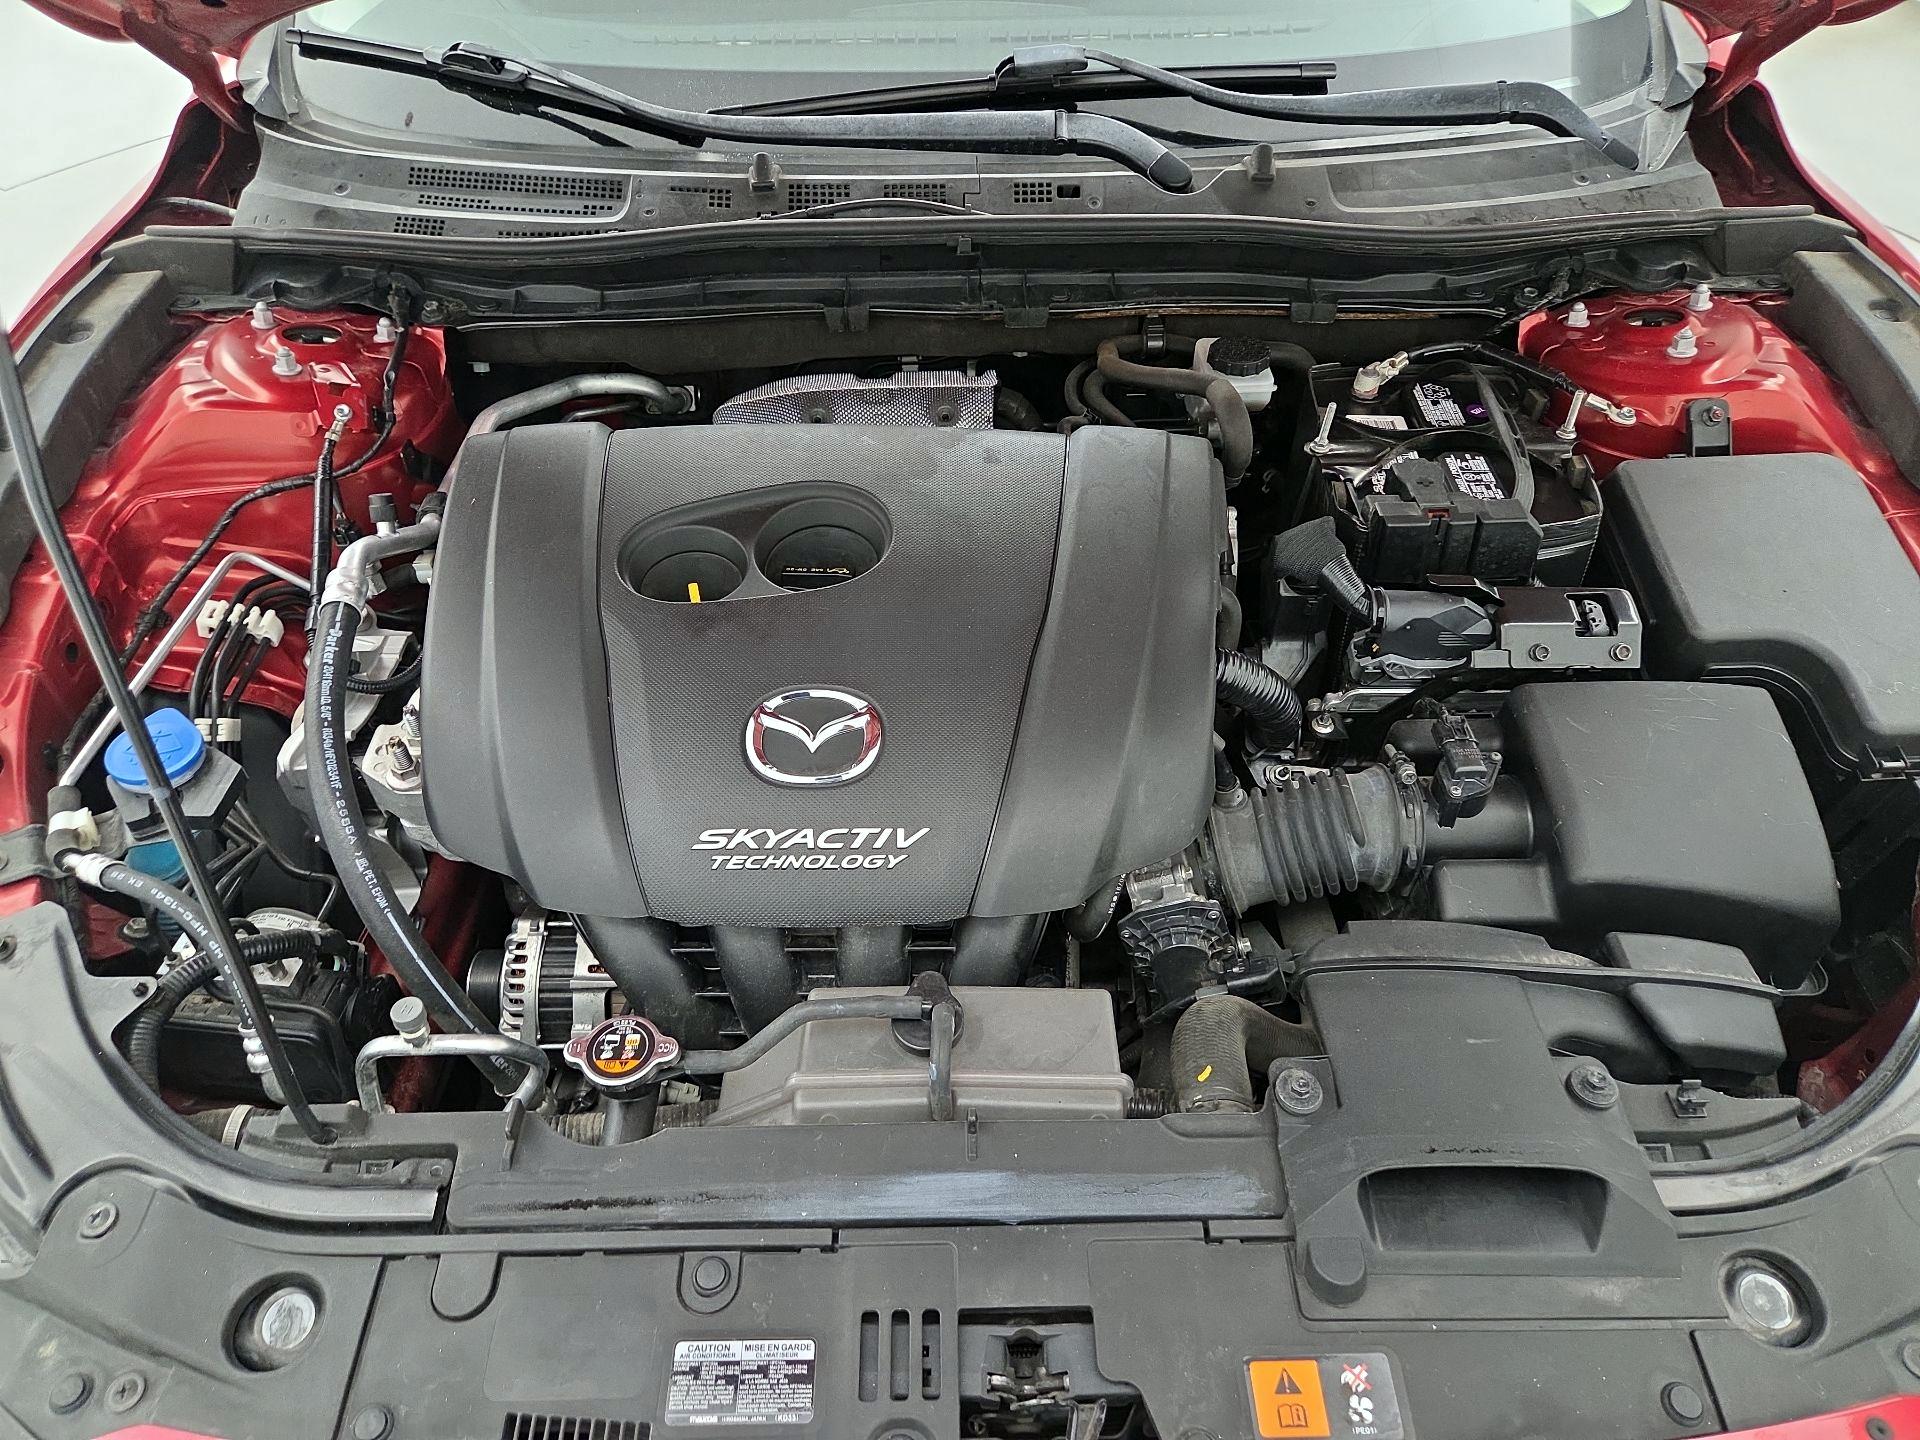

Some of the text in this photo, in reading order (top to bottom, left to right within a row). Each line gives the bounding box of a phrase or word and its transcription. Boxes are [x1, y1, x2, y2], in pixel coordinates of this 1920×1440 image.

[322, 628, 342, 668] Parker
[690, 827, 931, 850] SKYACTIV
[711, 854, 909, 870] TECHNOLOGY
[657, 1042, 676, 1053] HCC
[687, 1343, 731, 1353] CAUTION
[744, 1343, 812, 1352] MISE EN GARDE
